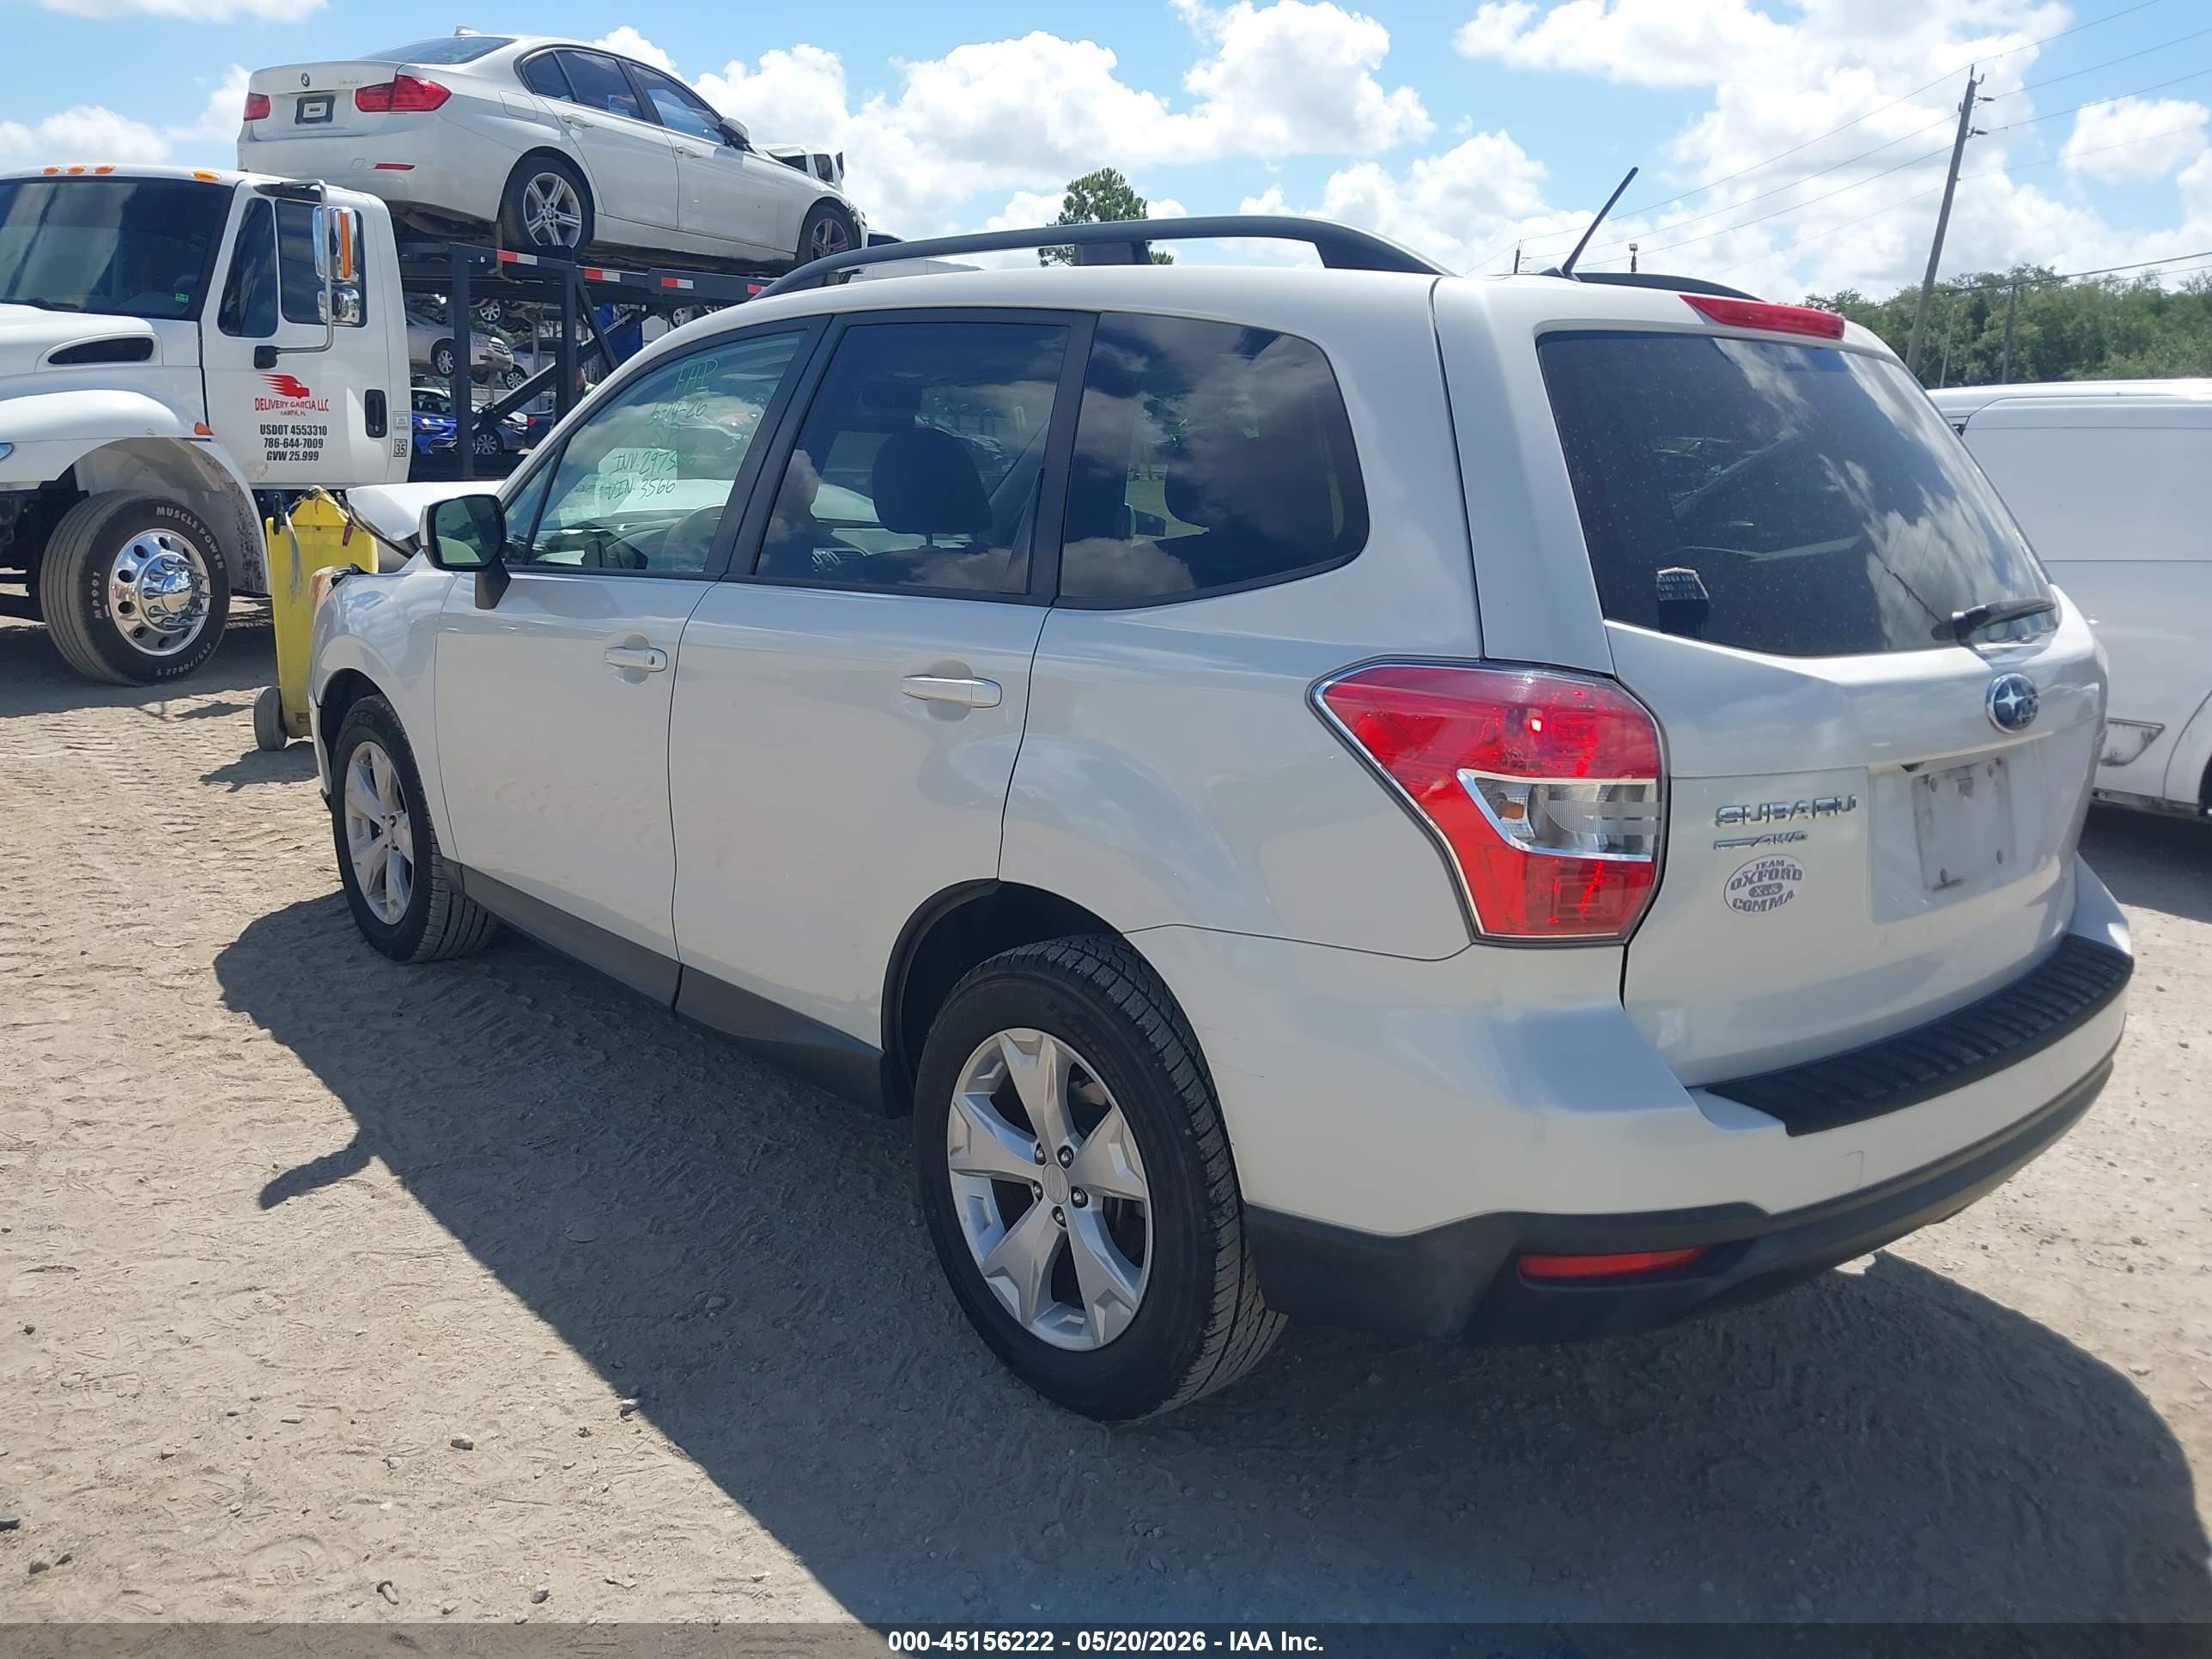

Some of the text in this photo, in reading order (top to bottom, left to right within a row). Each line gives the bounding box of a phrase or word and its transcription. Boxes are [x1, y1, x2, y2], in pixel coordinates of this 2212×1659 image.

[254, 397, 329, 411] DELIVERY GARCIA LLC
[259, 423, 328, 436] USDOT 4553310
[264, 437, 324, 448] 786-644-7009
[395, 443, 406, 455] 35
[266, 450, 319, 461] GVW 25.999
[638, 477, 677, 501] 3566
[156, 506, 224, 569] MUSCLE POWER
[1715, 794, 1857, 828] SUBARU
[1755, 859, 1786, 871] TEAM
[1729, 867, 1803, 890] OXFORD
[1732, 889, 1796, 913] COMMA
